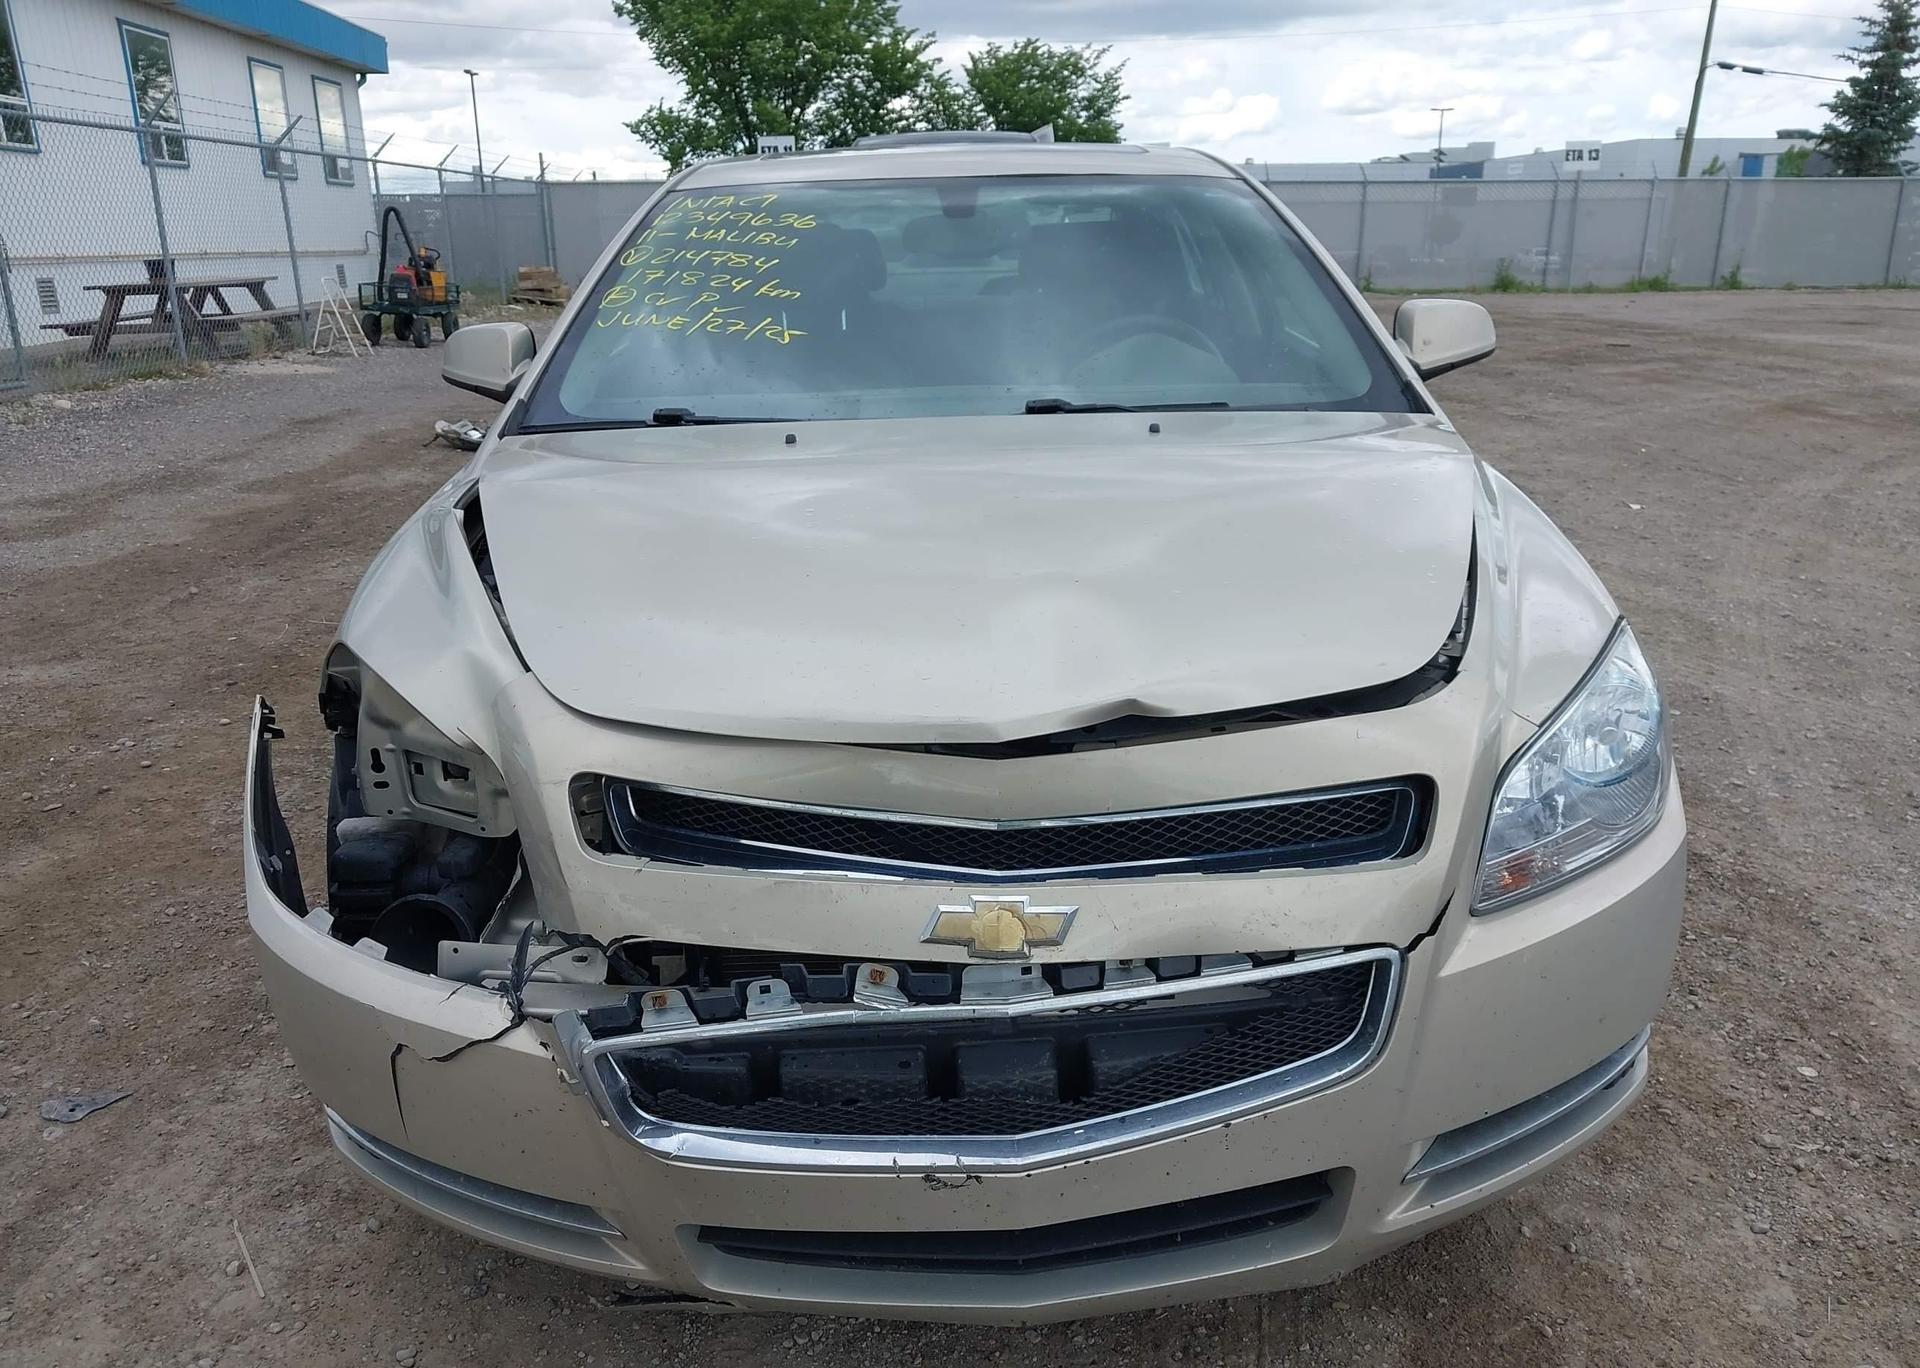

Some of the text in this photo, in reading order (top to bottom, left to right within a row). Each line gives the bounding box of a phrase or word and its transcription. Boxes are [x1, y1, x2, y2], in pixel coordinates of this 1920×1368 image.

[1565, 148, 1600, 161] ETA 13
[651, 211, 817, 229] 12349636
[685, 226, 799, 249] MALIBU
[650, 248, 780, 274] 214784
